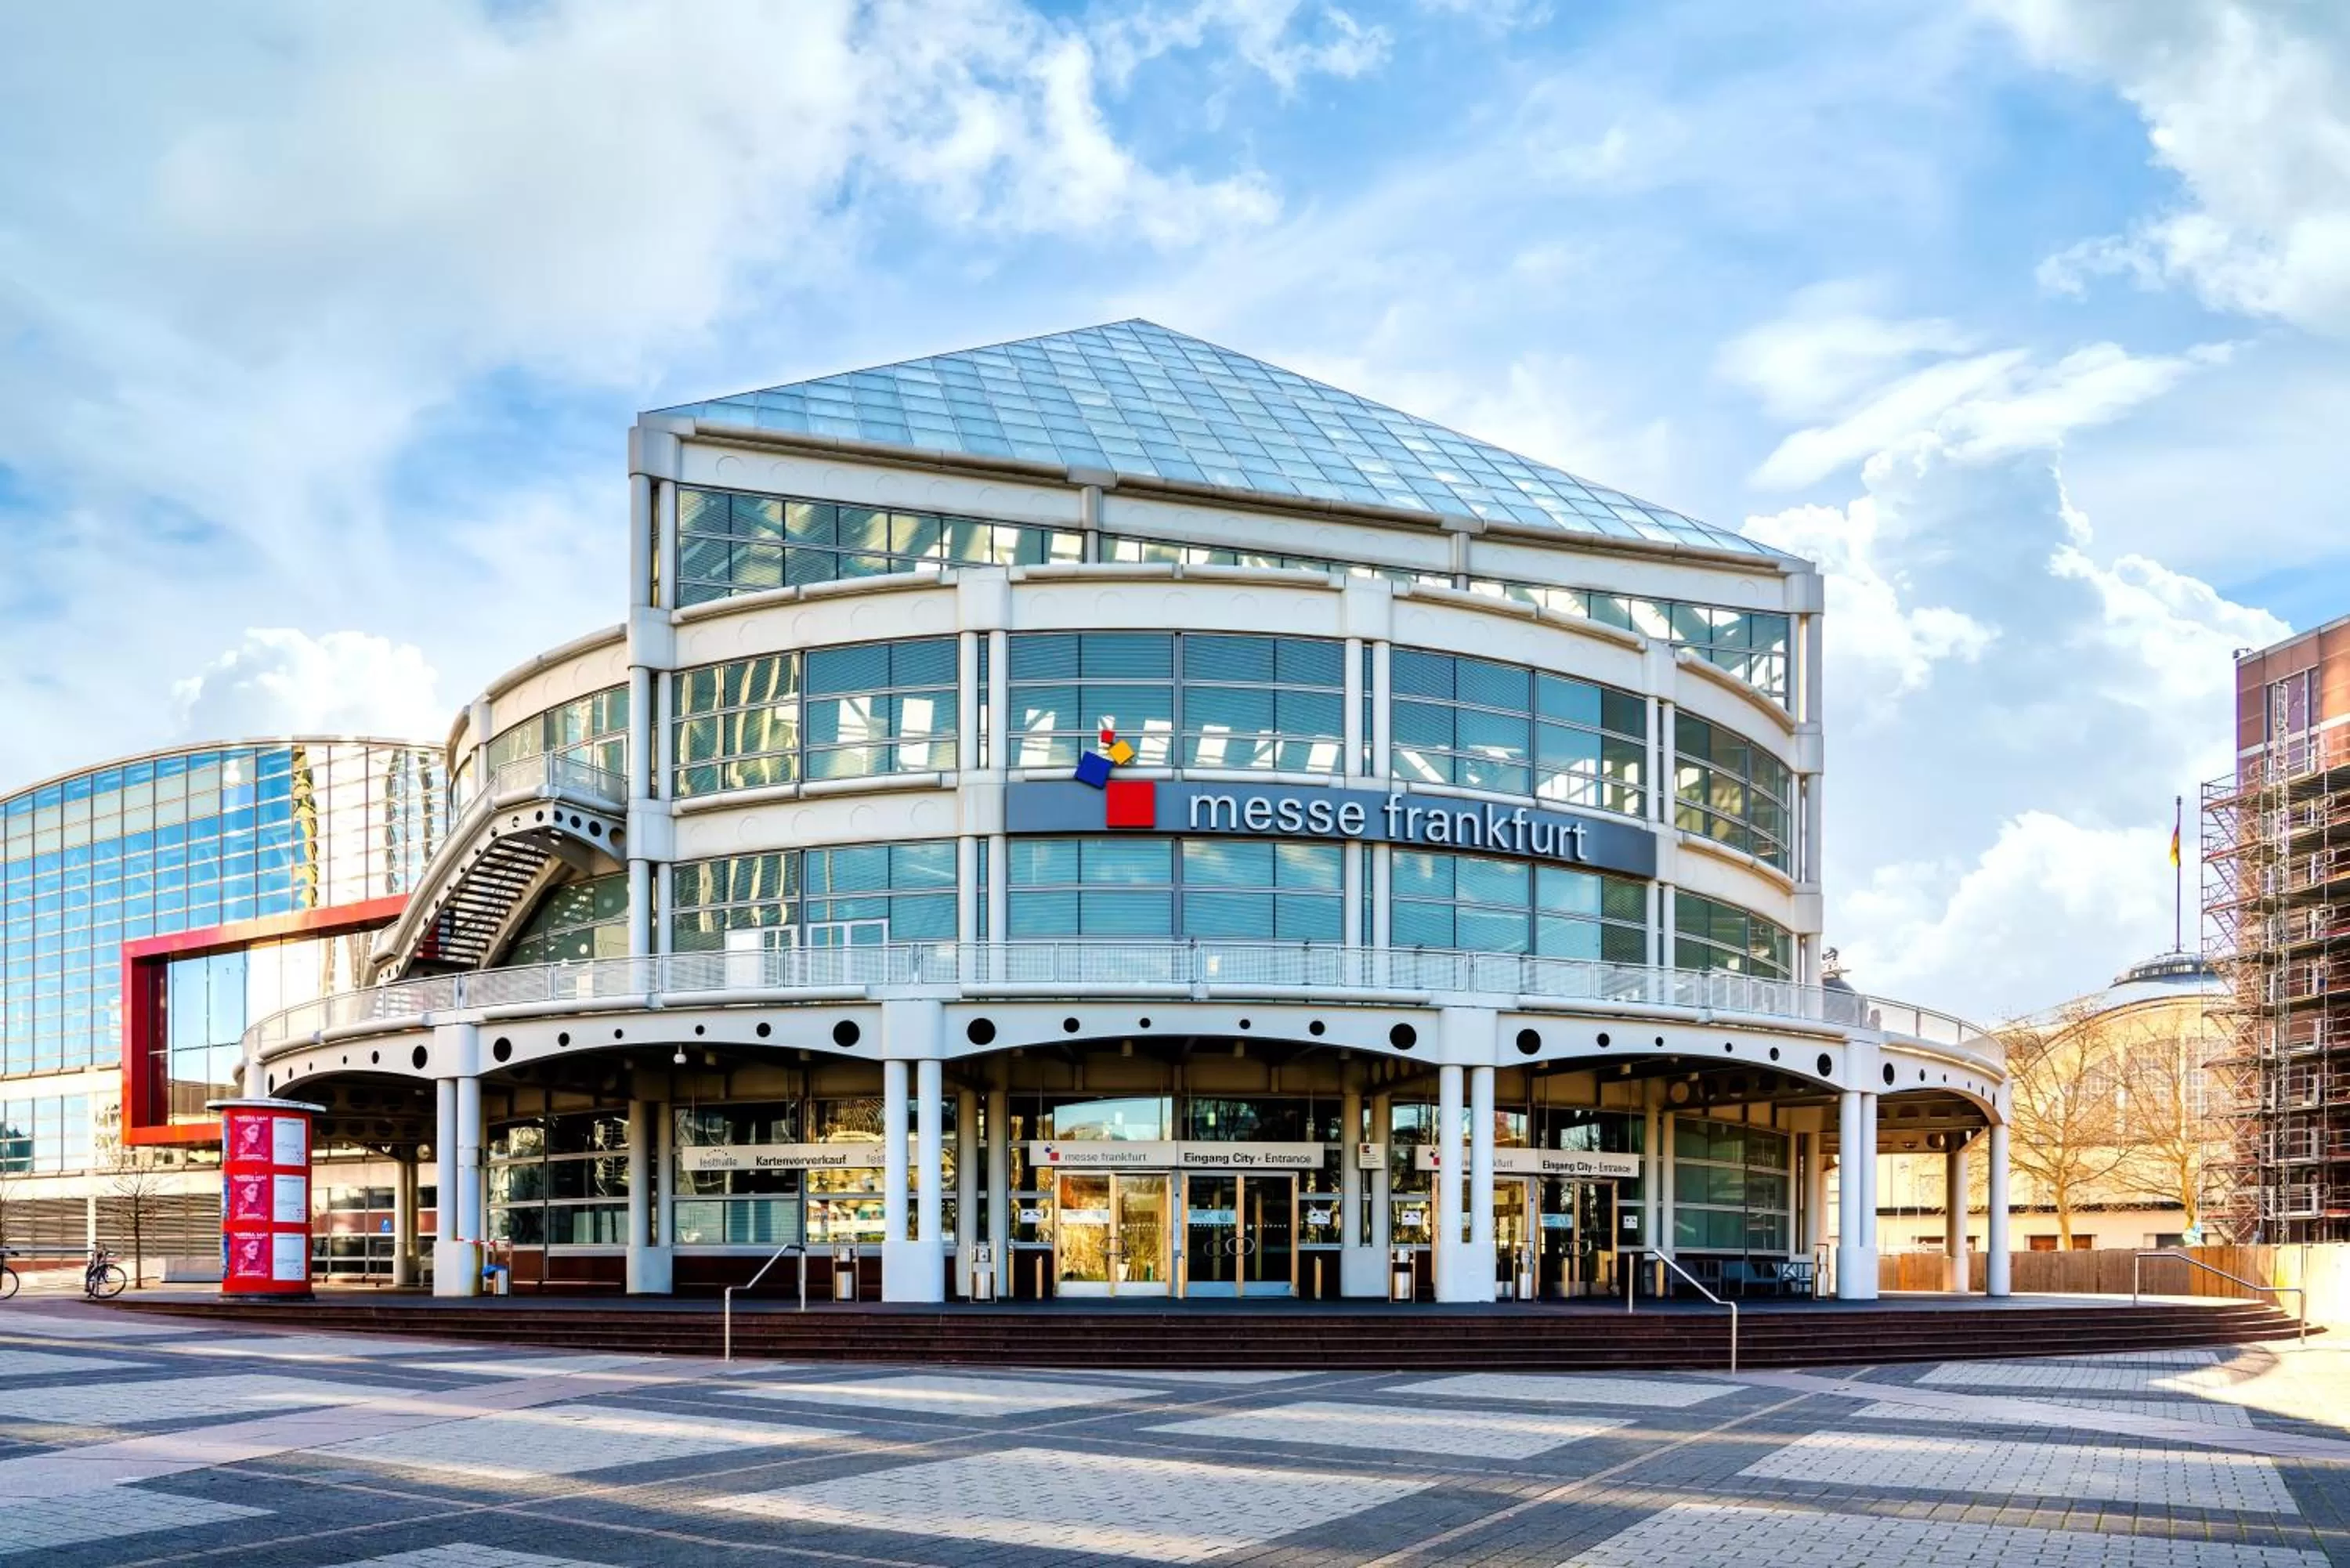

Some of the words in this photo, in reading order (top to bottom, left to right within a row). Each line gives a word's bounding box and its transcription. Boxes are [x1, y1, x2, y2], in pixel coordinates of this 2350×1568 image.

[1189, 793, 1366, 837] messe
[1383, 793, 1589, 862] frankfurt
[755, 1154, 847, 1166] Kartenvorverkauf
[1065, 1153, 1098, 1162] messe
[1100, 1152, 1148, 1162] frankfurt
[1183, 1152, 1230, 1165] Eingang
[1232, 1152, 1254, 1165] City
[1265, 1152, 1312, 1164] Entrance
[1542, 1160, 1575, 1172] Eingang
[1576, 1162, 1593, 1172] City
[1599, 1162, 1632, 1173] Entrance
